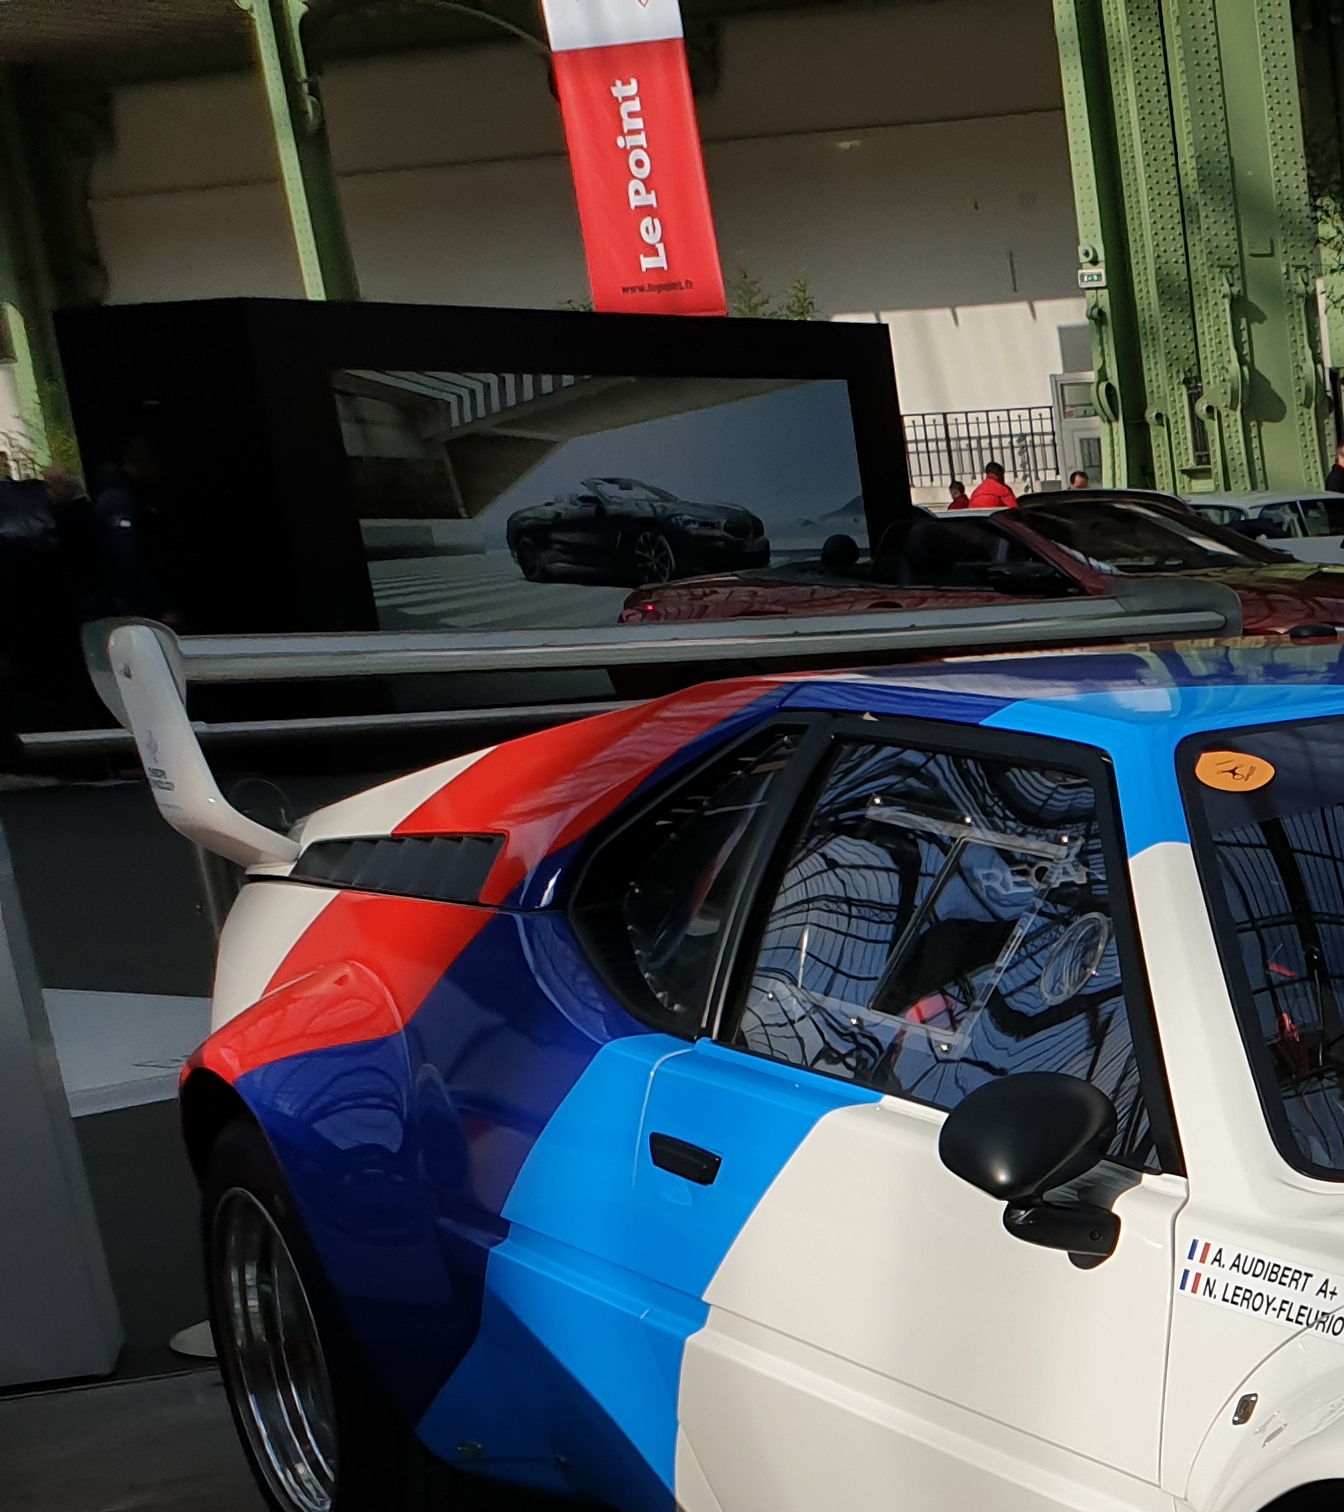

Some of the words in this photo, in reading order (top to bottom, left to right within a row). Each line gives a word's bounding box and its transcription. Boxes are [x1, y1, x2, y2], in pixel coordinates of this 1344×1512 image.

[611, 77, 659, 210] Point
[639, 216, 668, 272] Le
[1203, 1276, 1217, 1300] N.
[1210, 1247, 1226, 1269] A.
[1229, 1252, 1313, 1293] AUDIBERT
[1316, 1278, 1339, 1301] A+
